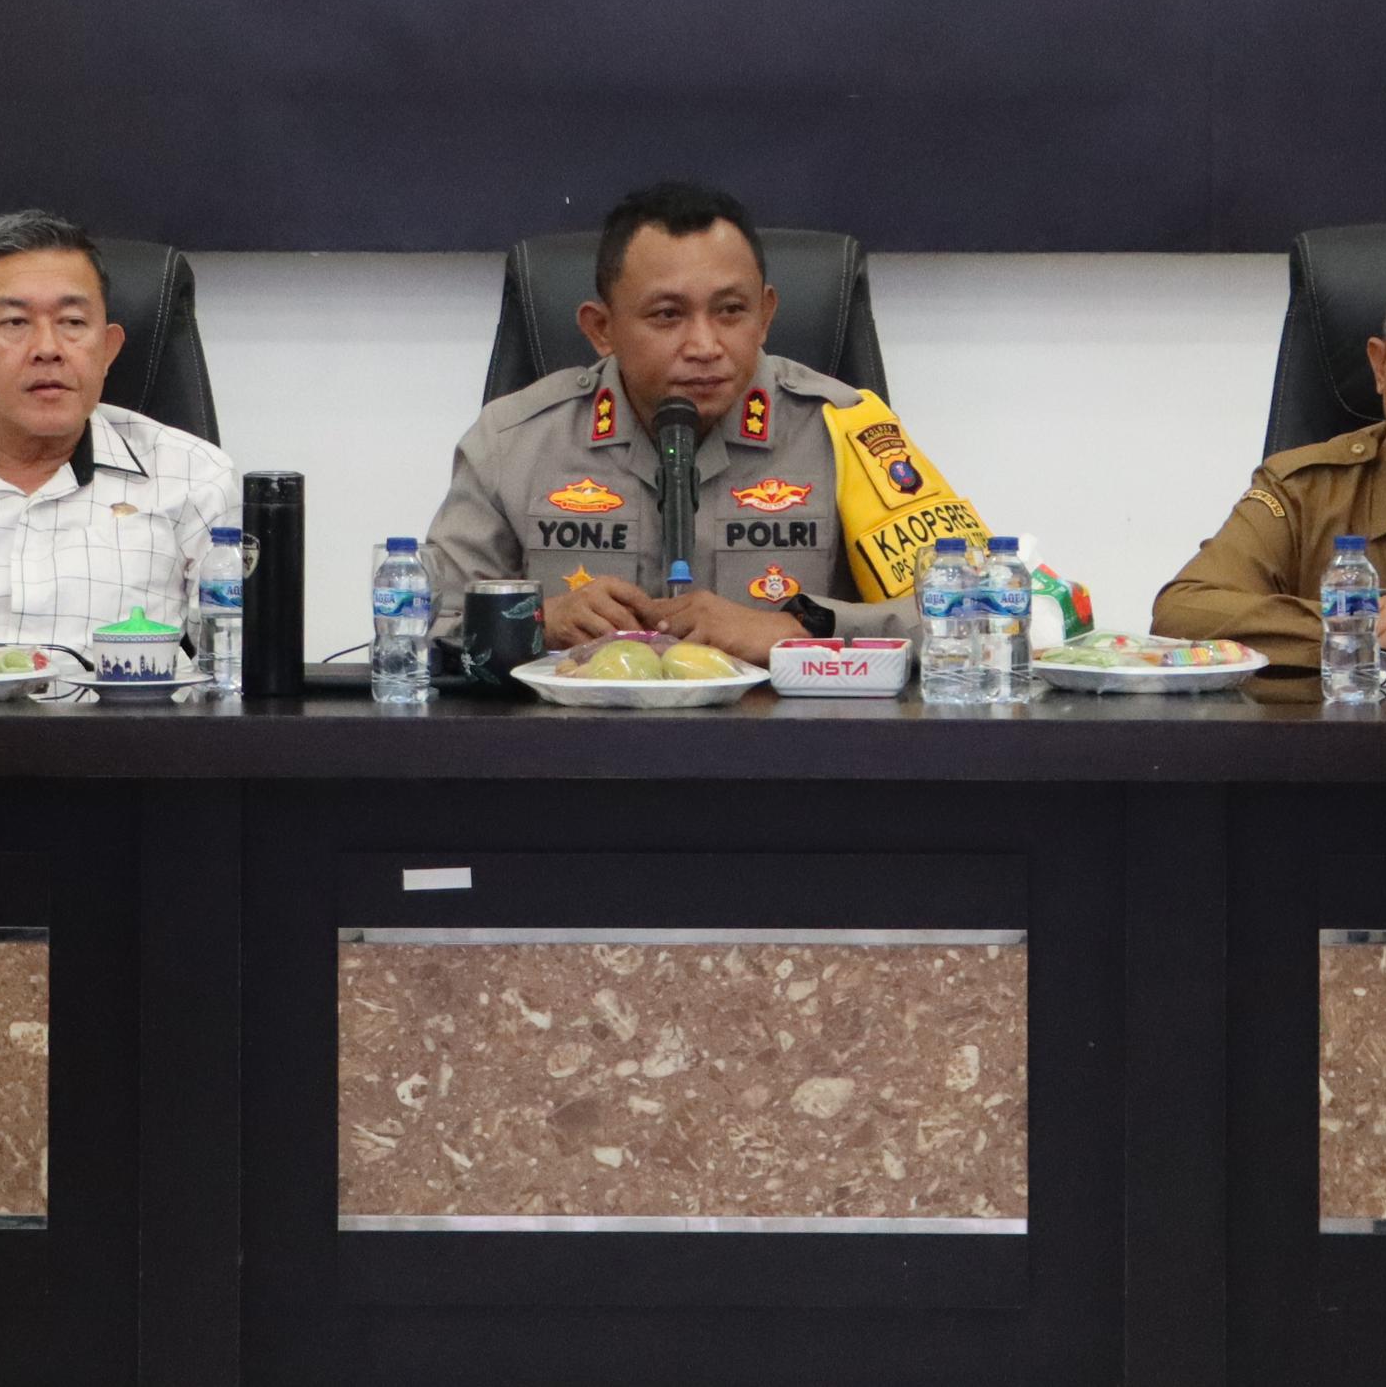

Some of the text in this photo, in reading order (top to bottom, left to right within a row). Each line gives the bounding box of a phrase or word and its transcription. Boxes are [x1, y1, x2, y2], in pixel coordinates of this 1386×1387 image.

[538, 520, 628, 550] YON.E
[726, 521, 817, 548] POLRI
[873, 503, 980, 562] KAOPSRES
[801, 660, 868, 676] INSTA
